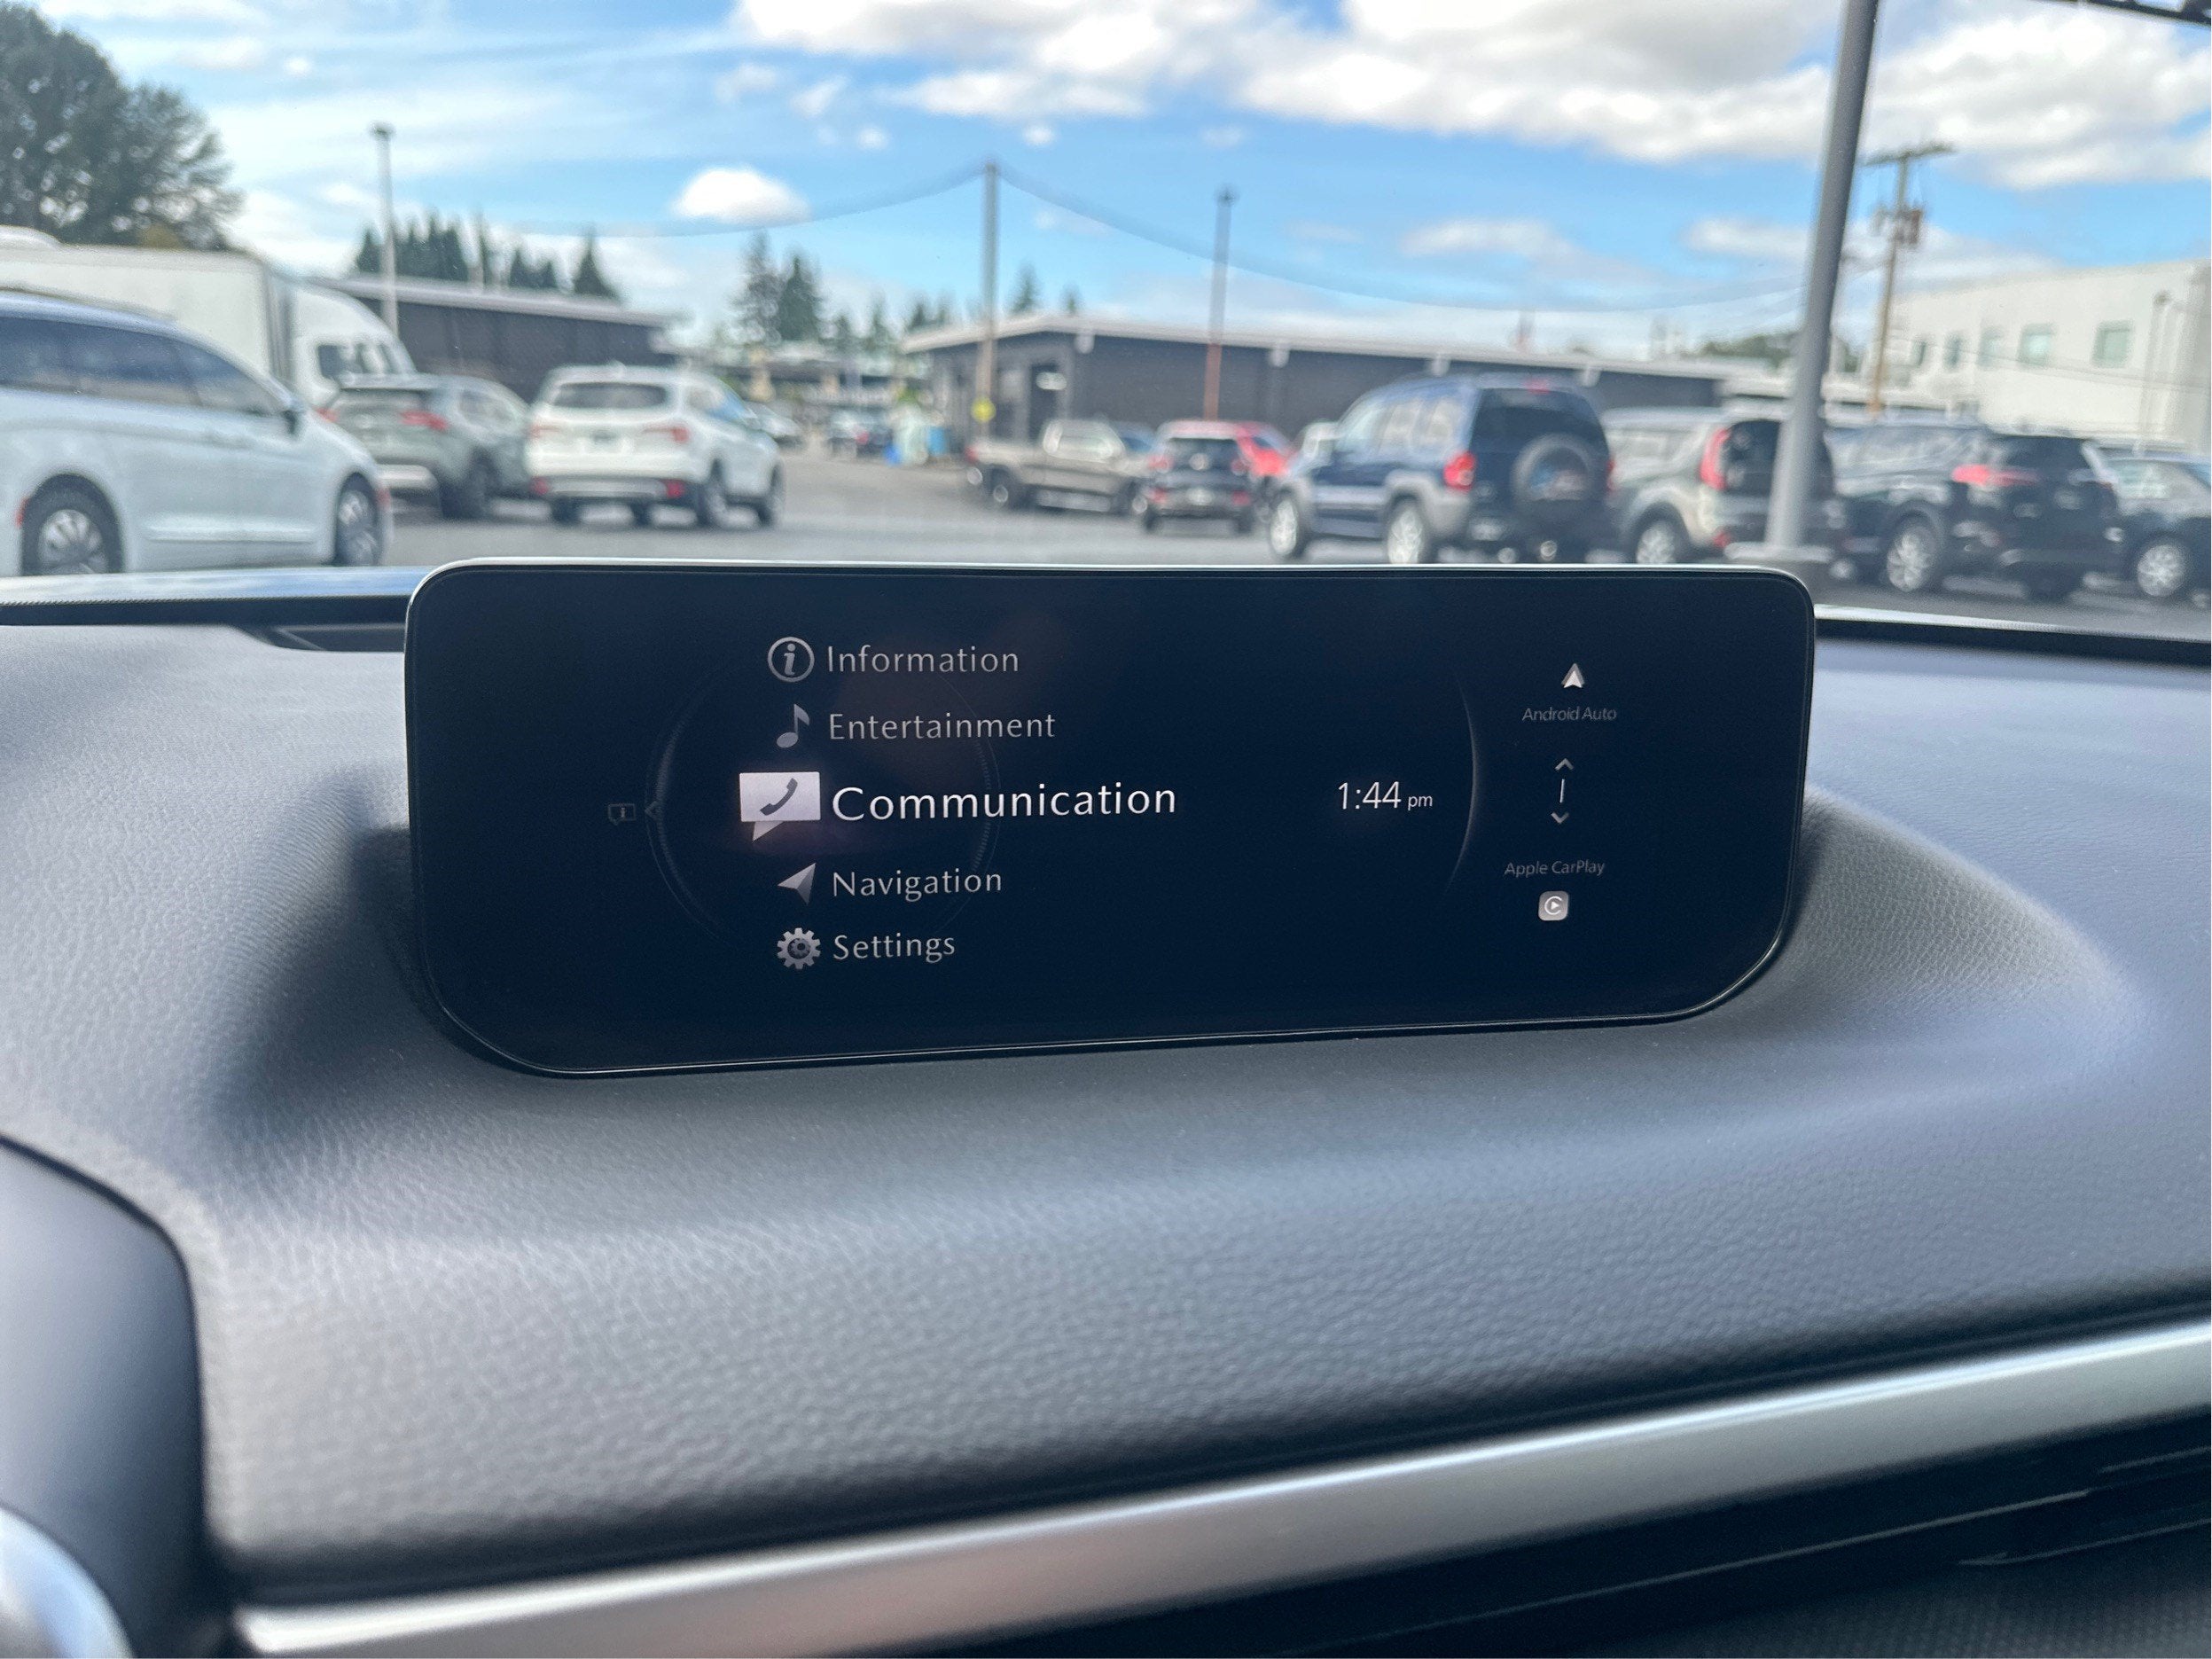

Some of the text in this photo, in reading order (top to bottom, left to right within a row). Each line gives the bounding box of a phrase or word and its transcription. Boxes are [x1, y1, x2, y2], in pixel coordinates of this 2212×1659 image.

[827, 644, 1020, 674] Information
[829, 712, 1057, 740] Entertainment
[1521, 706, 1618, 722] Android Auto
[832, 781, 1176, 822] Communication
[1337, 780, 1434, 811] 1:44 pm
[1504, 859, 1606, 879] Apple CarPlay
[832, 867, 1003, 903] Navigation
[832, 932, 956, 964] Settings
